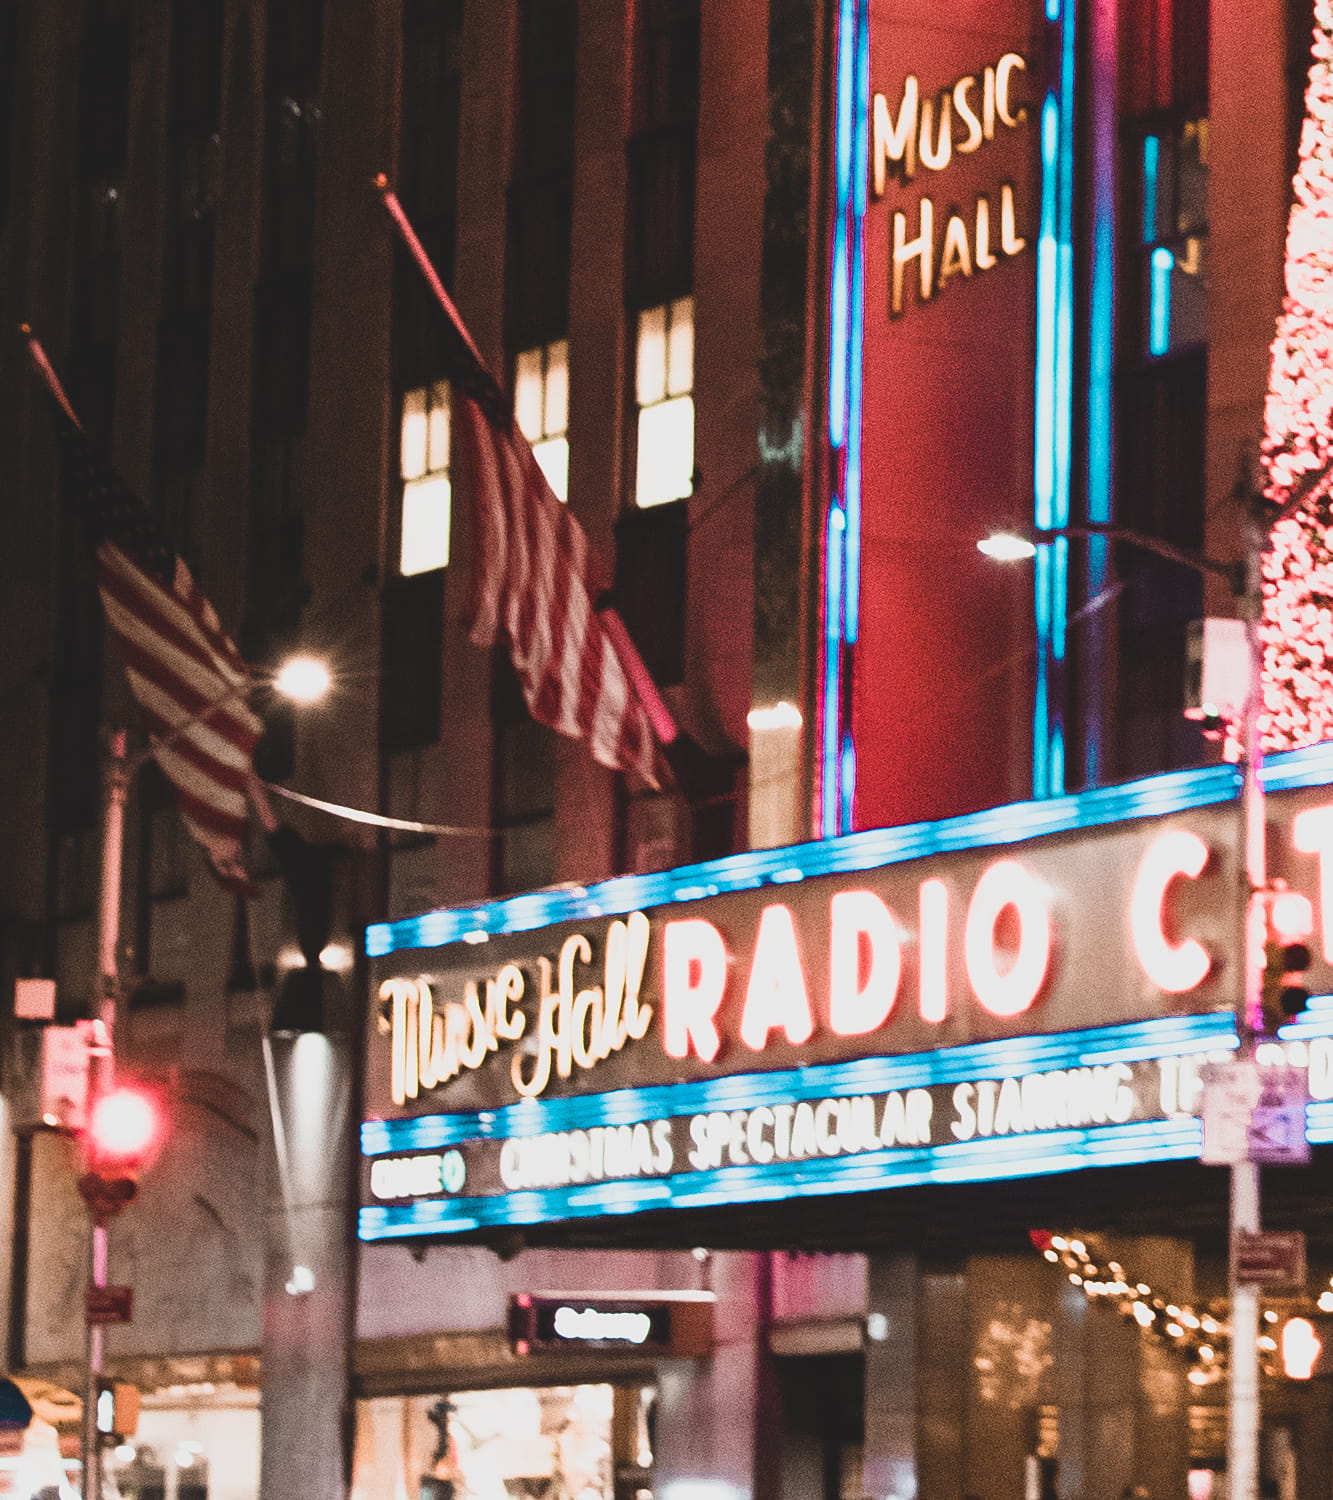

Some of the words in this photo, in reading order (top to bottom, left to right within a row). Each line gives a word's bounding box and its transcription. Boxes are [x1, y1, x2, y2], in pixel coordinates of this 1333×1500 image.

[888, 186, 1026, 317] HALL
[379, 962, 527, 1106] Music
[511, 912, 653, 1098] Hall
[661, 857, 1053, 1062] RADIO
[689, 1087, 933, 1170] SPECTACULAR
